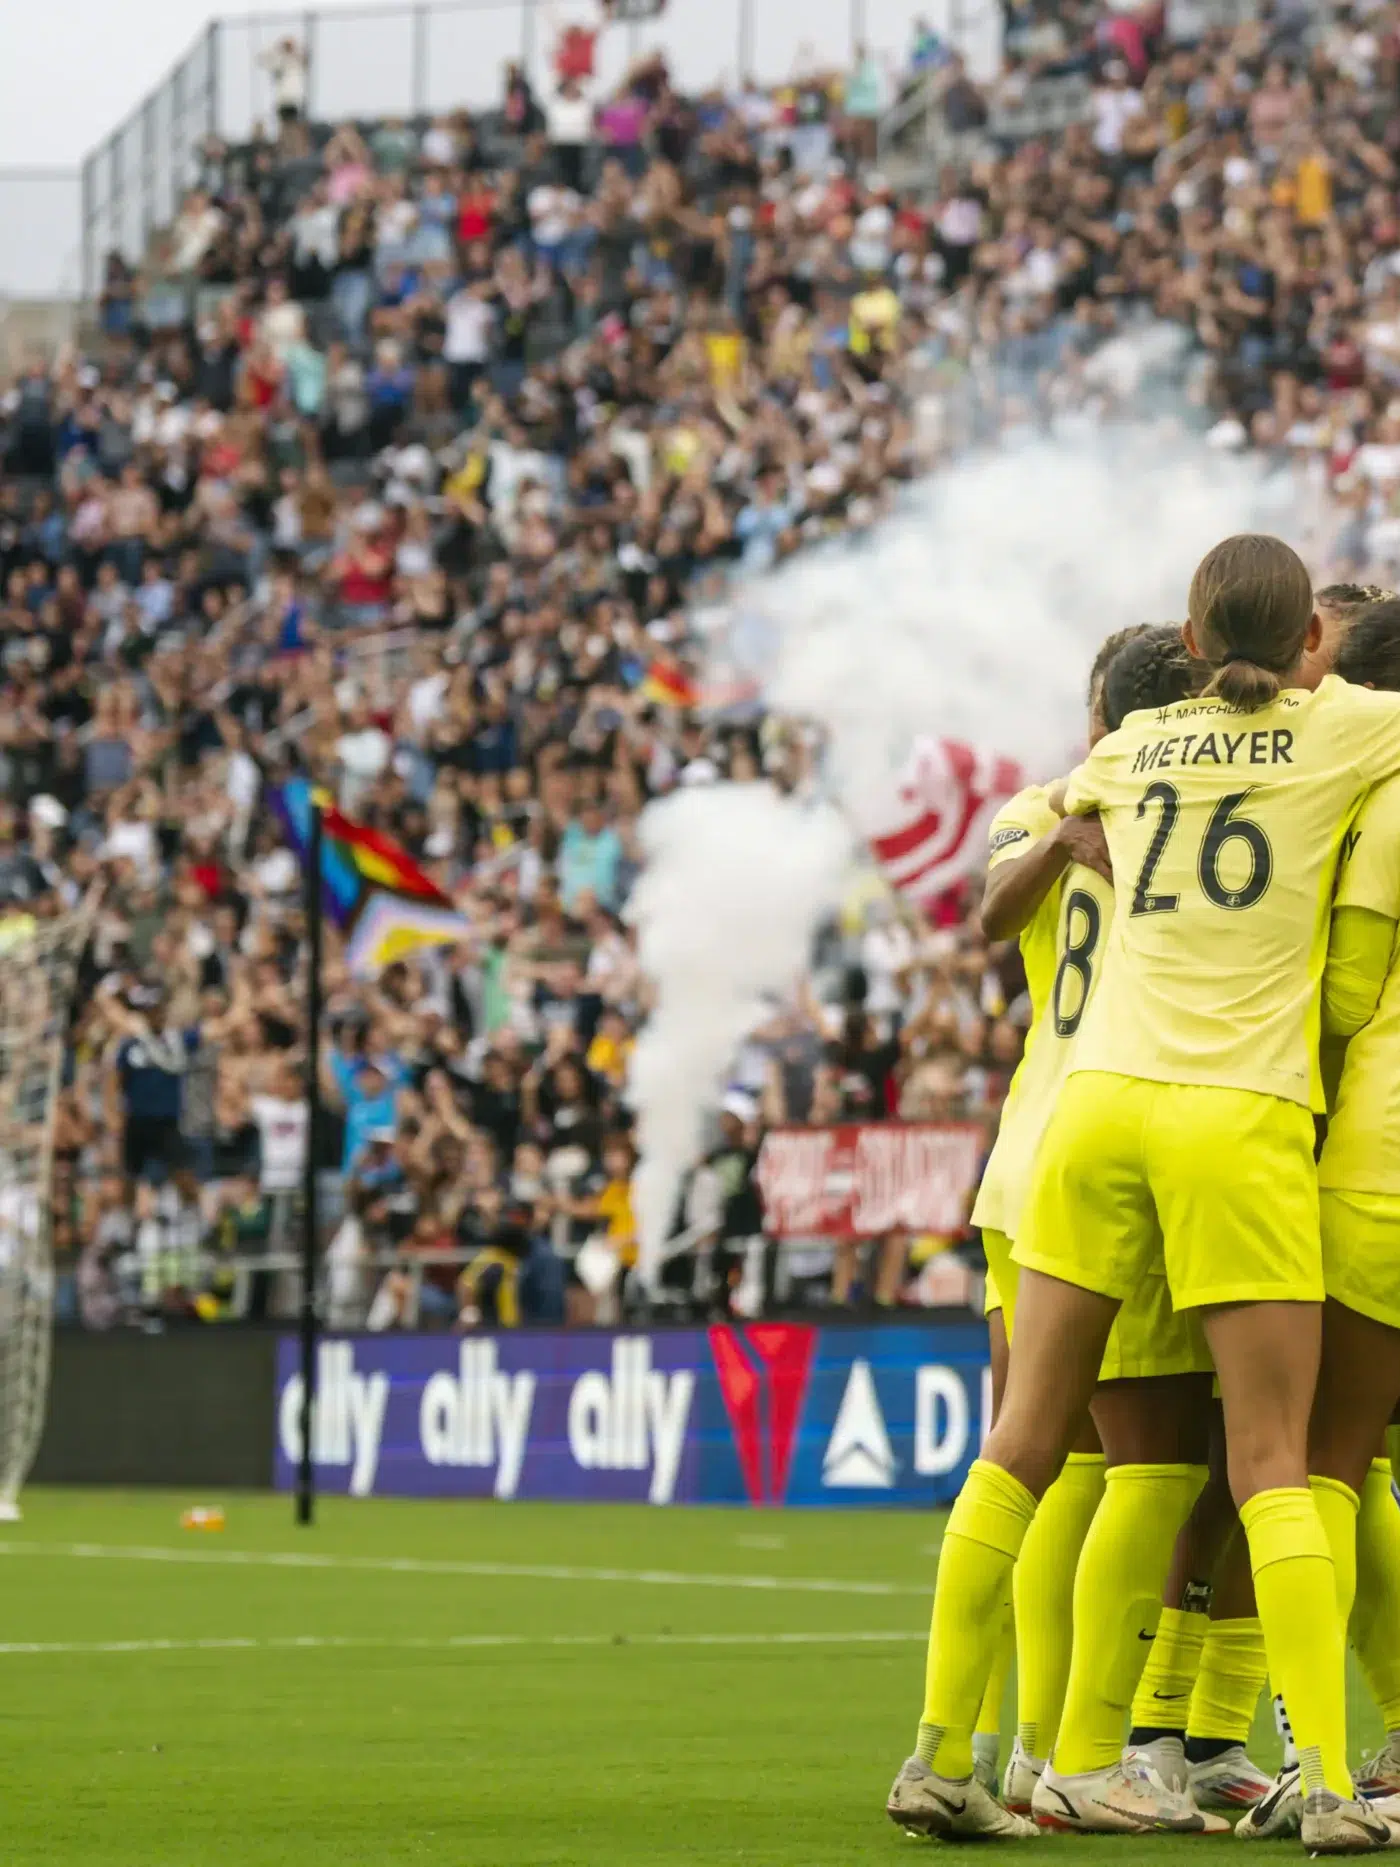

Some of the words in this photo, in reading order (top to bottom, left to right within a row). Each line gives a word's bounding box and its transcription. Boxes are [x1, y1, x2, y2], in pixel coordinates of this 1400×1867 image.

[1131, 729, 1294, 774] METAYER
[1129, 779, 1274, 918] 26
[1053, 888, 1102, 1039] 8
[279, 1340, 390, 1498] ally
[420, 1337, 537, 1499] ally
[567, 1335, 696, 1506] ally
